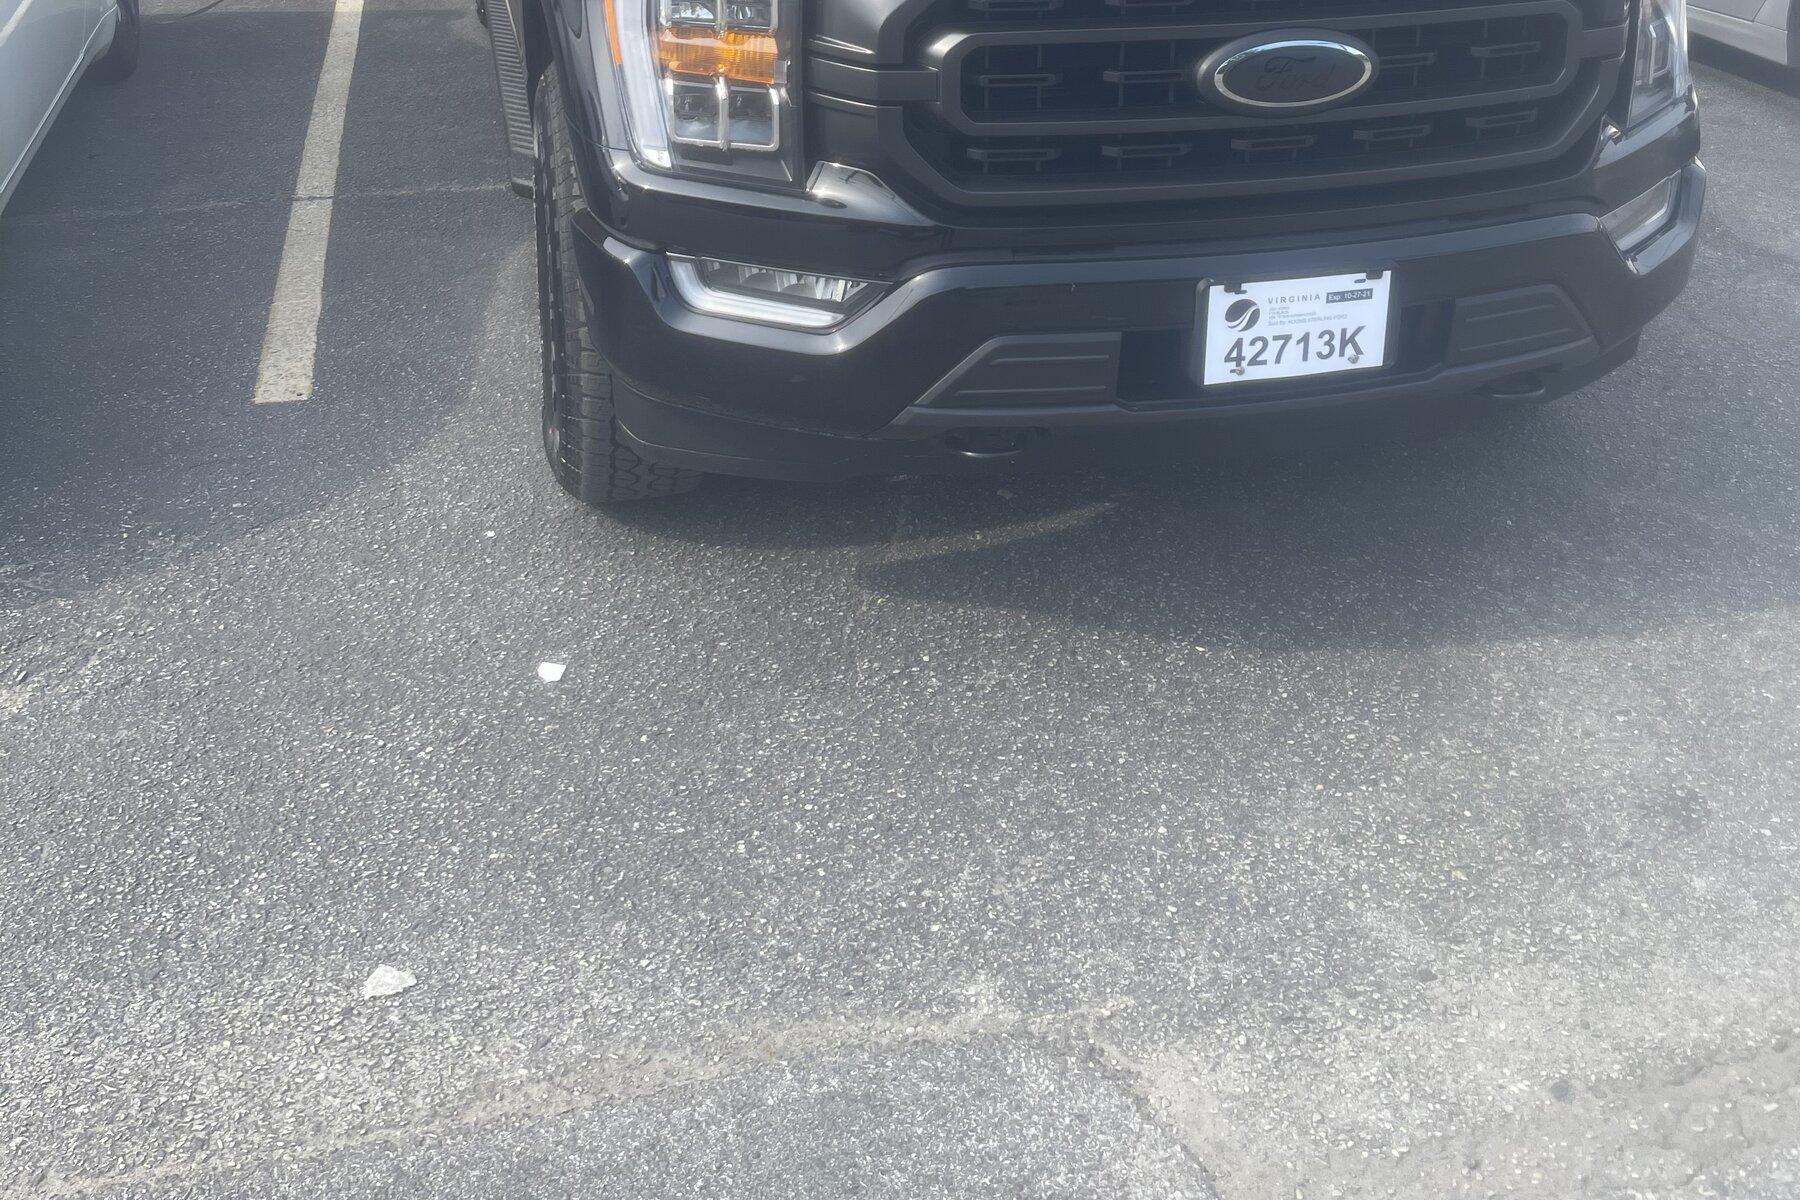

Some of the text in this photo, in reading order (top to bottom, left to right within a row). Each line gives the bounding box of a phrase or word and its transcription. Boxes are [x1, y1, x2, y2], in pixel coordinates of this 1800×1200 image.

[1255, 55, 1337, 91] Ford
[1268, 293, 1320, 305] VIRGINIA
[1223, 325, 1367, 369] 42713K
